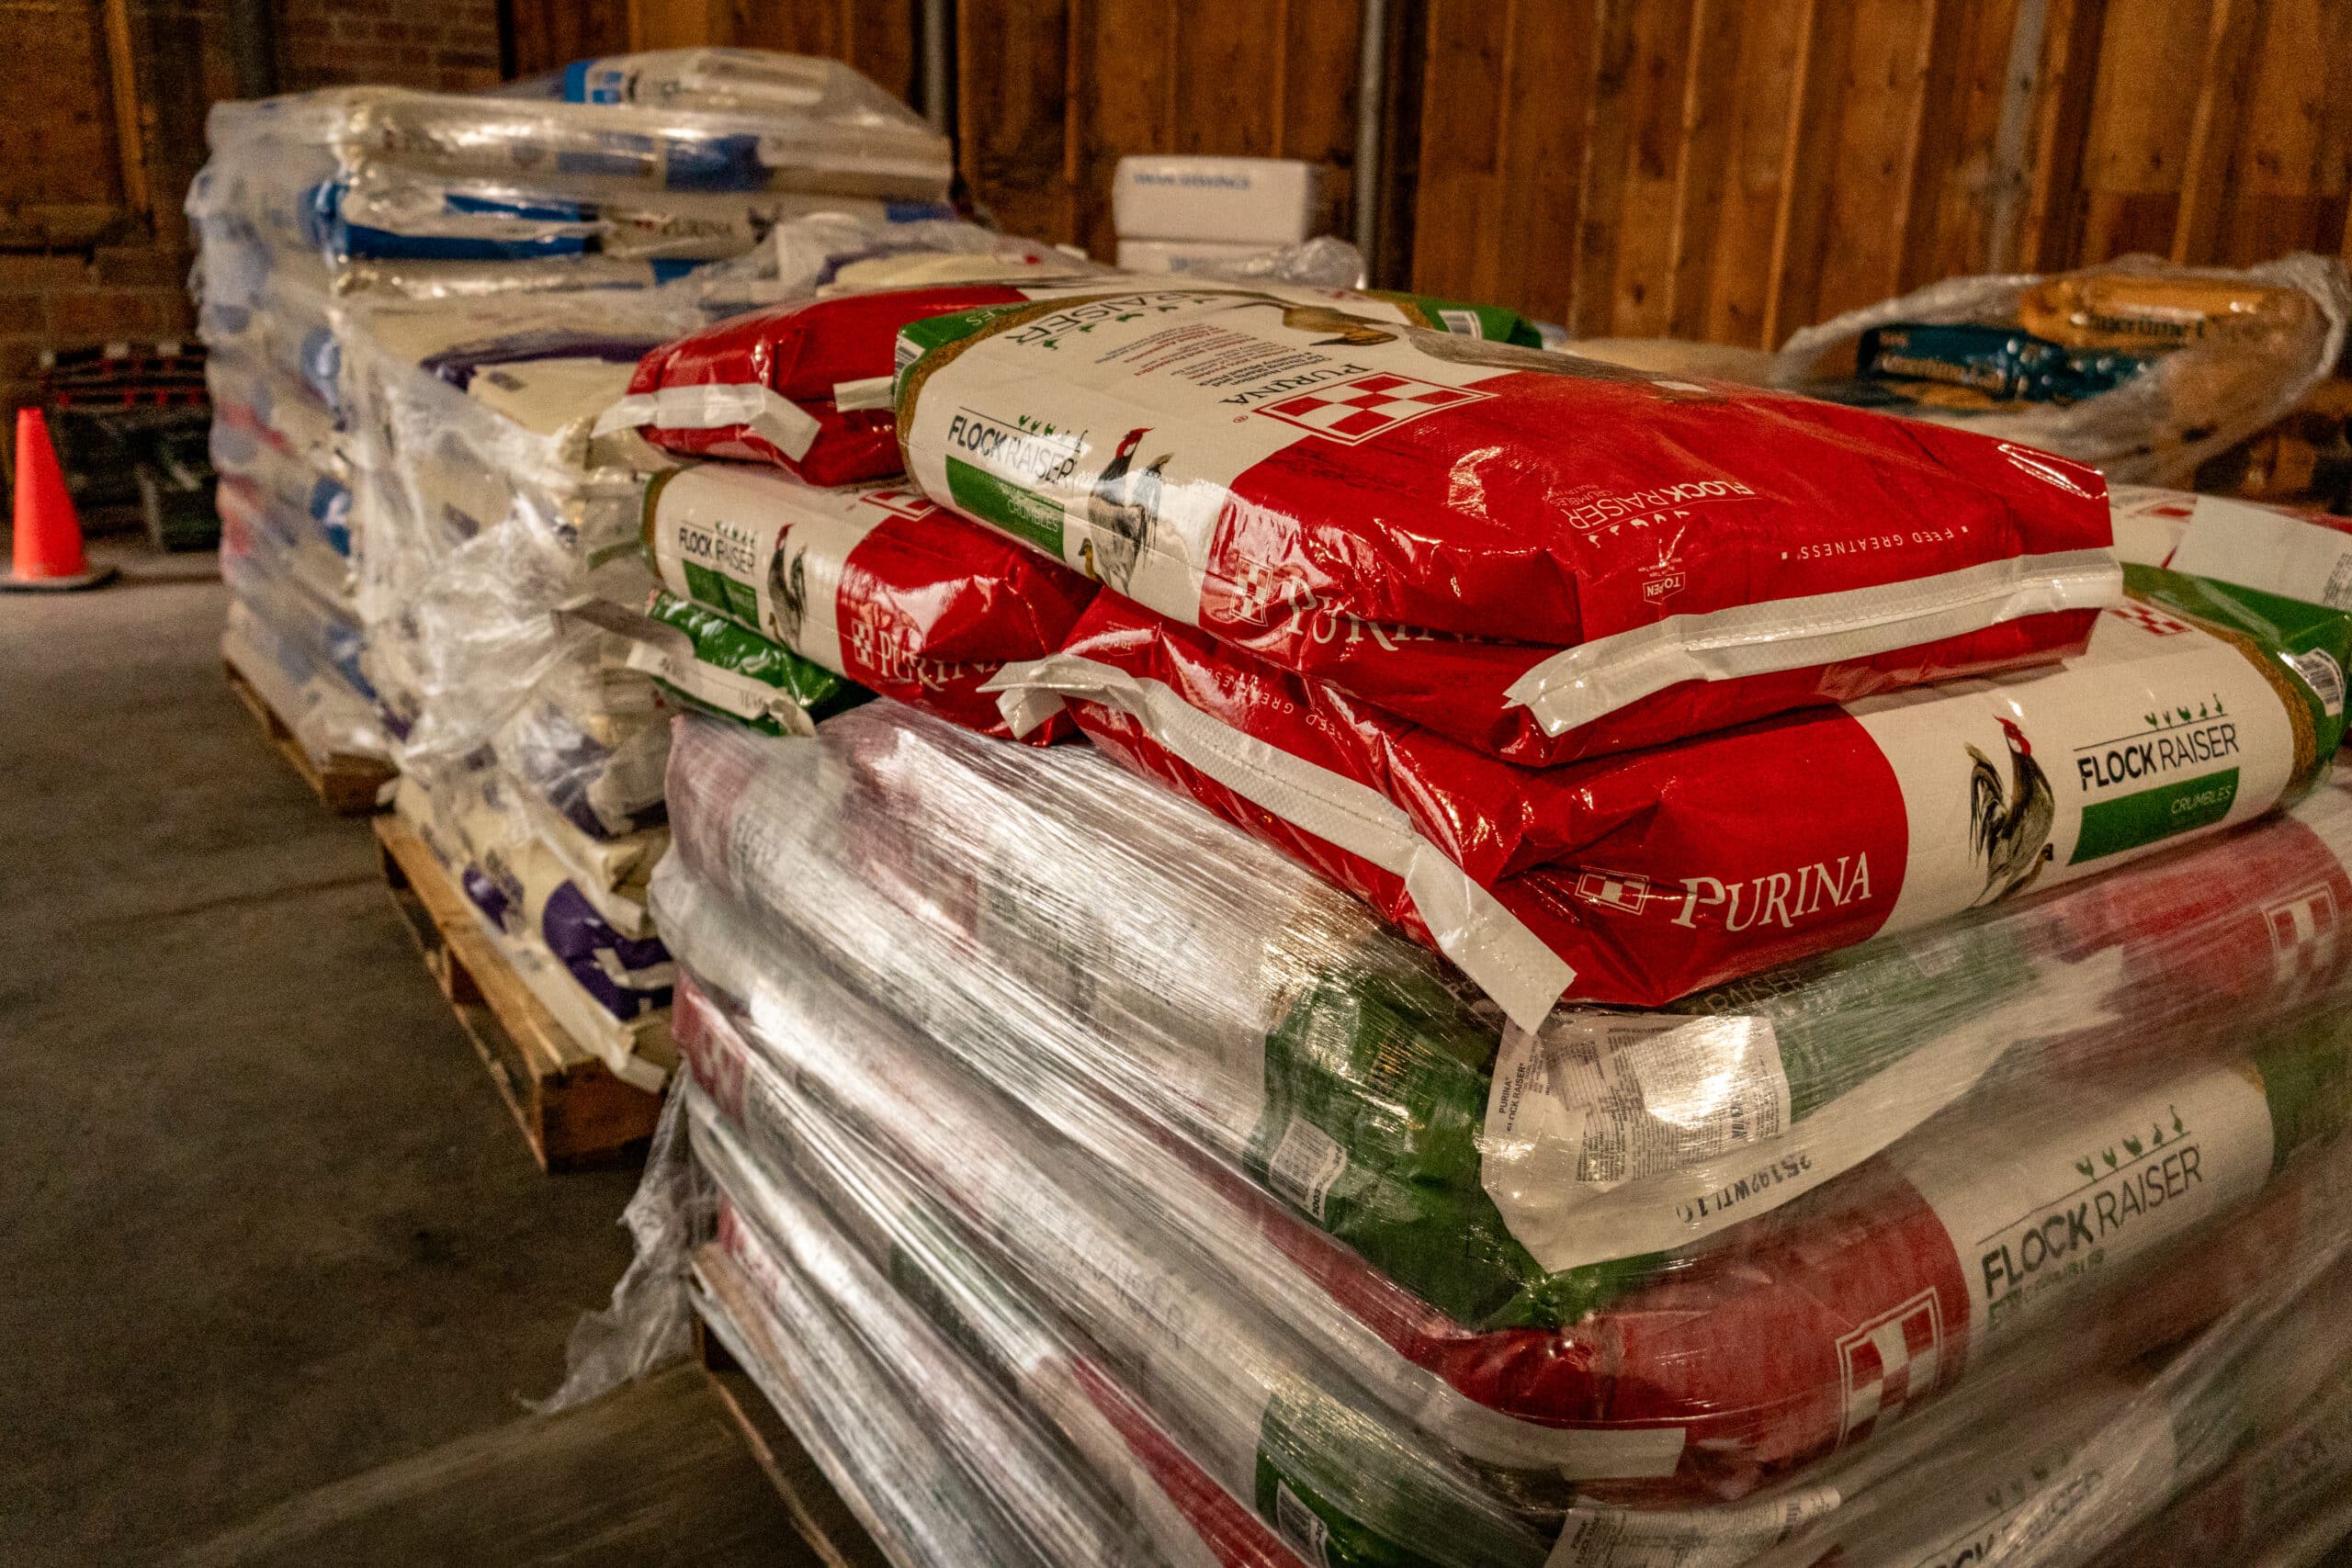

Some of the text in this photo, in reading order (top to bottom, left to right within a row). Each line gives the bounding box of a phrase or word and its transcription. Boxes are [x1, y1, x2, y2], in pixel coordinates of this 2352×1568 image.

[1219, 362, 1370, 405] PURINA
[1560, 480, 1756, 529] FLOCK RAISER
[1800, 527, 1955, 559] FEED GREATNESS
[2077, 723, 2240, 792] FLOCK RAISER
[2171, 784, 2233, 814] CRUMBLES
[1669, 851, 1871, 933] PURINA
[1498, 1077, 1512, 1114] PURINA
[1512, 1063, 1526, 1100] RAISER
[1981, 1145, 2203, 1298] FLOCK RAISER
